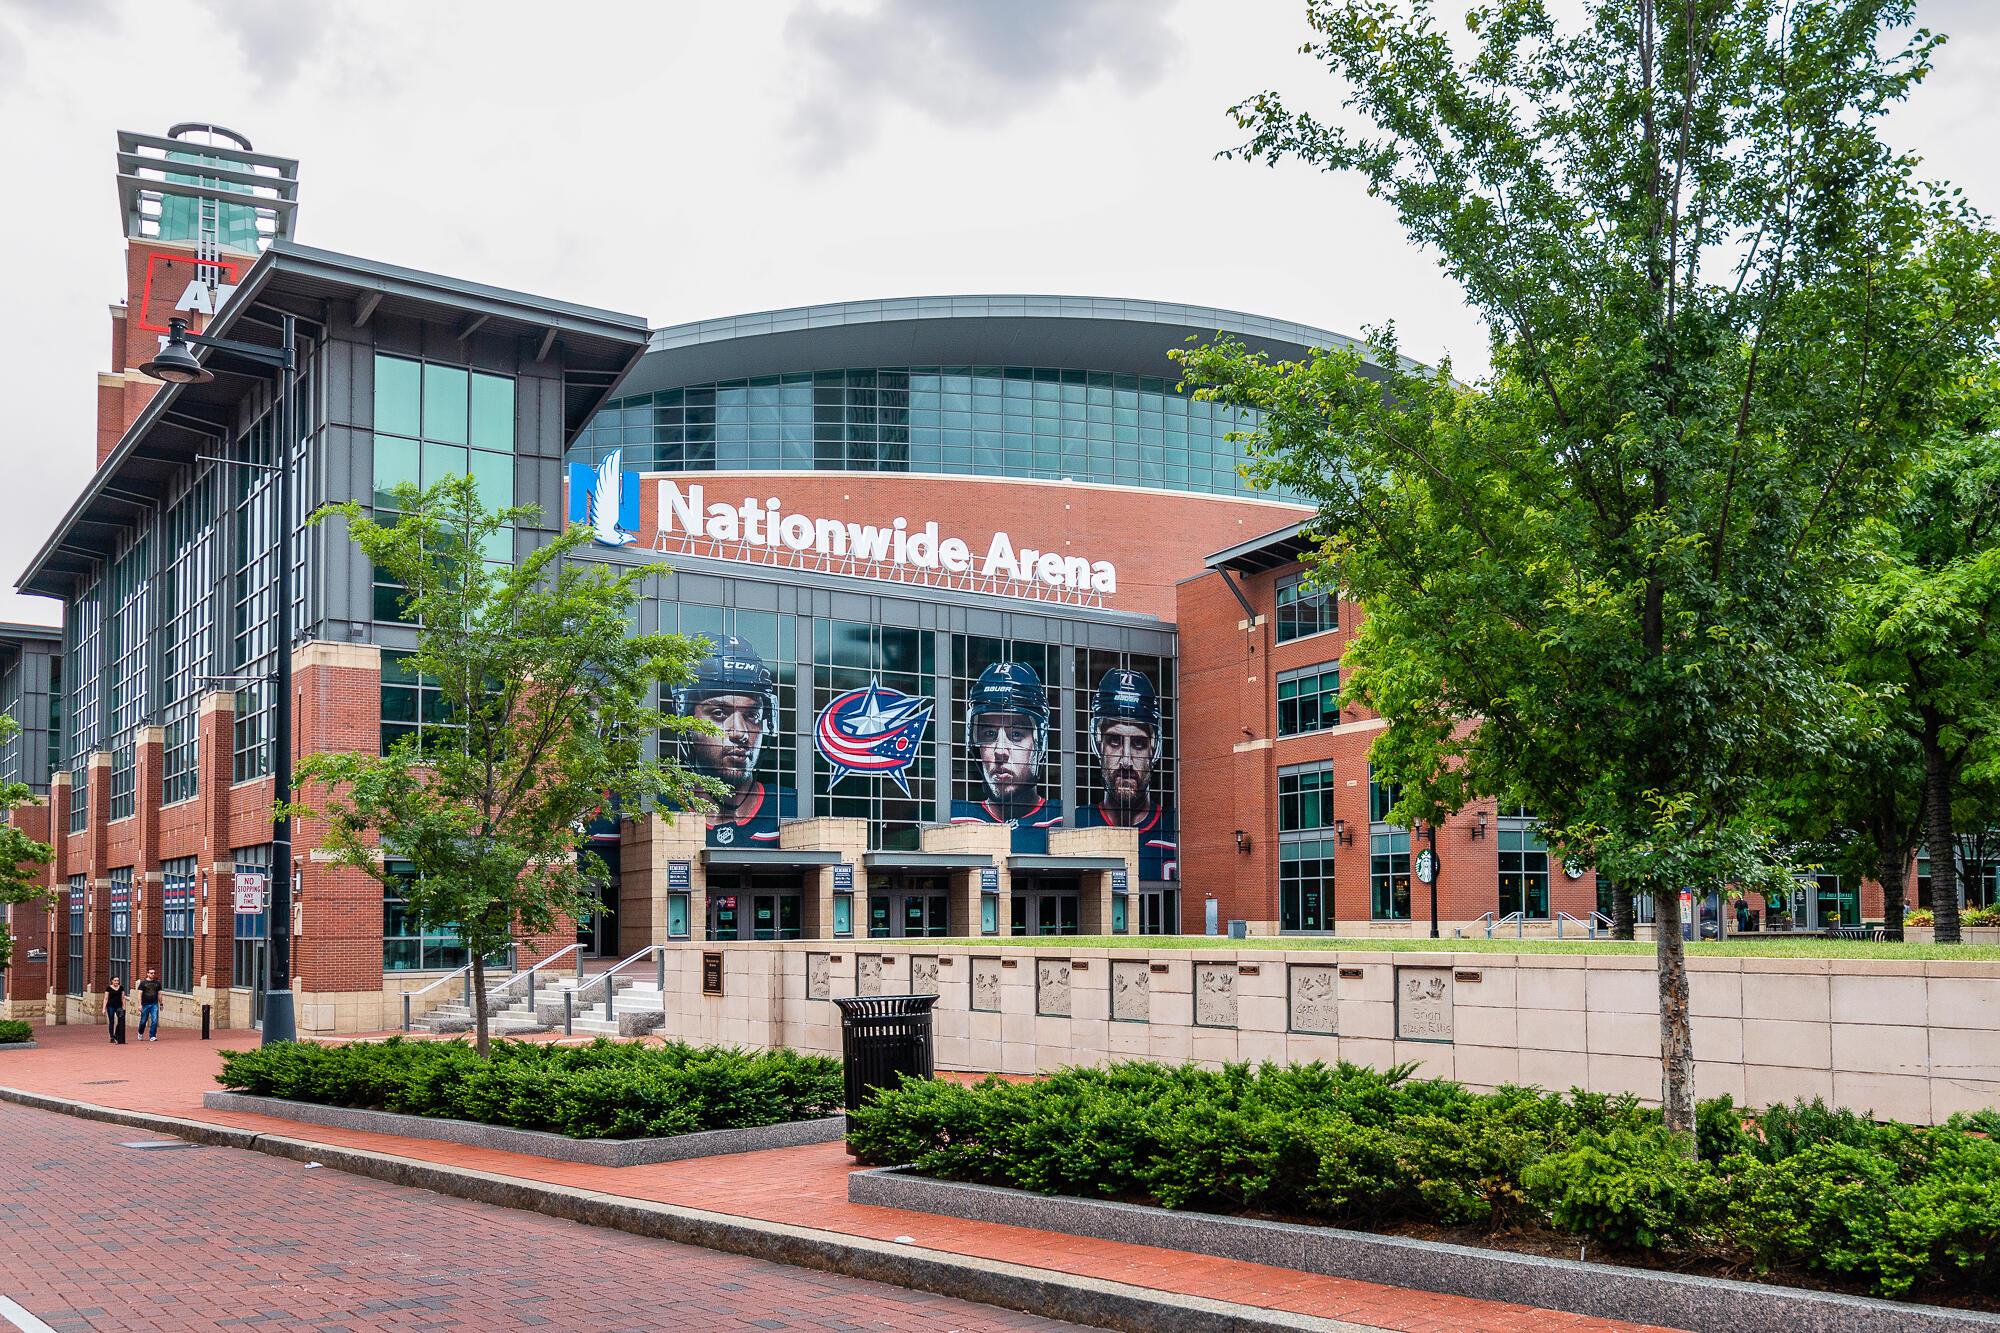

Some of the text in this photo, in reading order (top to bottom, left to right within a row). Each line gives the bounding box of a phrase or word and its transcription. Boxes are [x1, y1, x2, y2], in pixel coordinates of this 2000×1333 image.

[658, 480, 1117, 594] Nationwide Arena
[724, 661, 755, 671] CCM
[994, 663, 1012, 674] 13
[244, 877, 255, 885] NO
[1413, 1007, 1441, 1021] Brian
